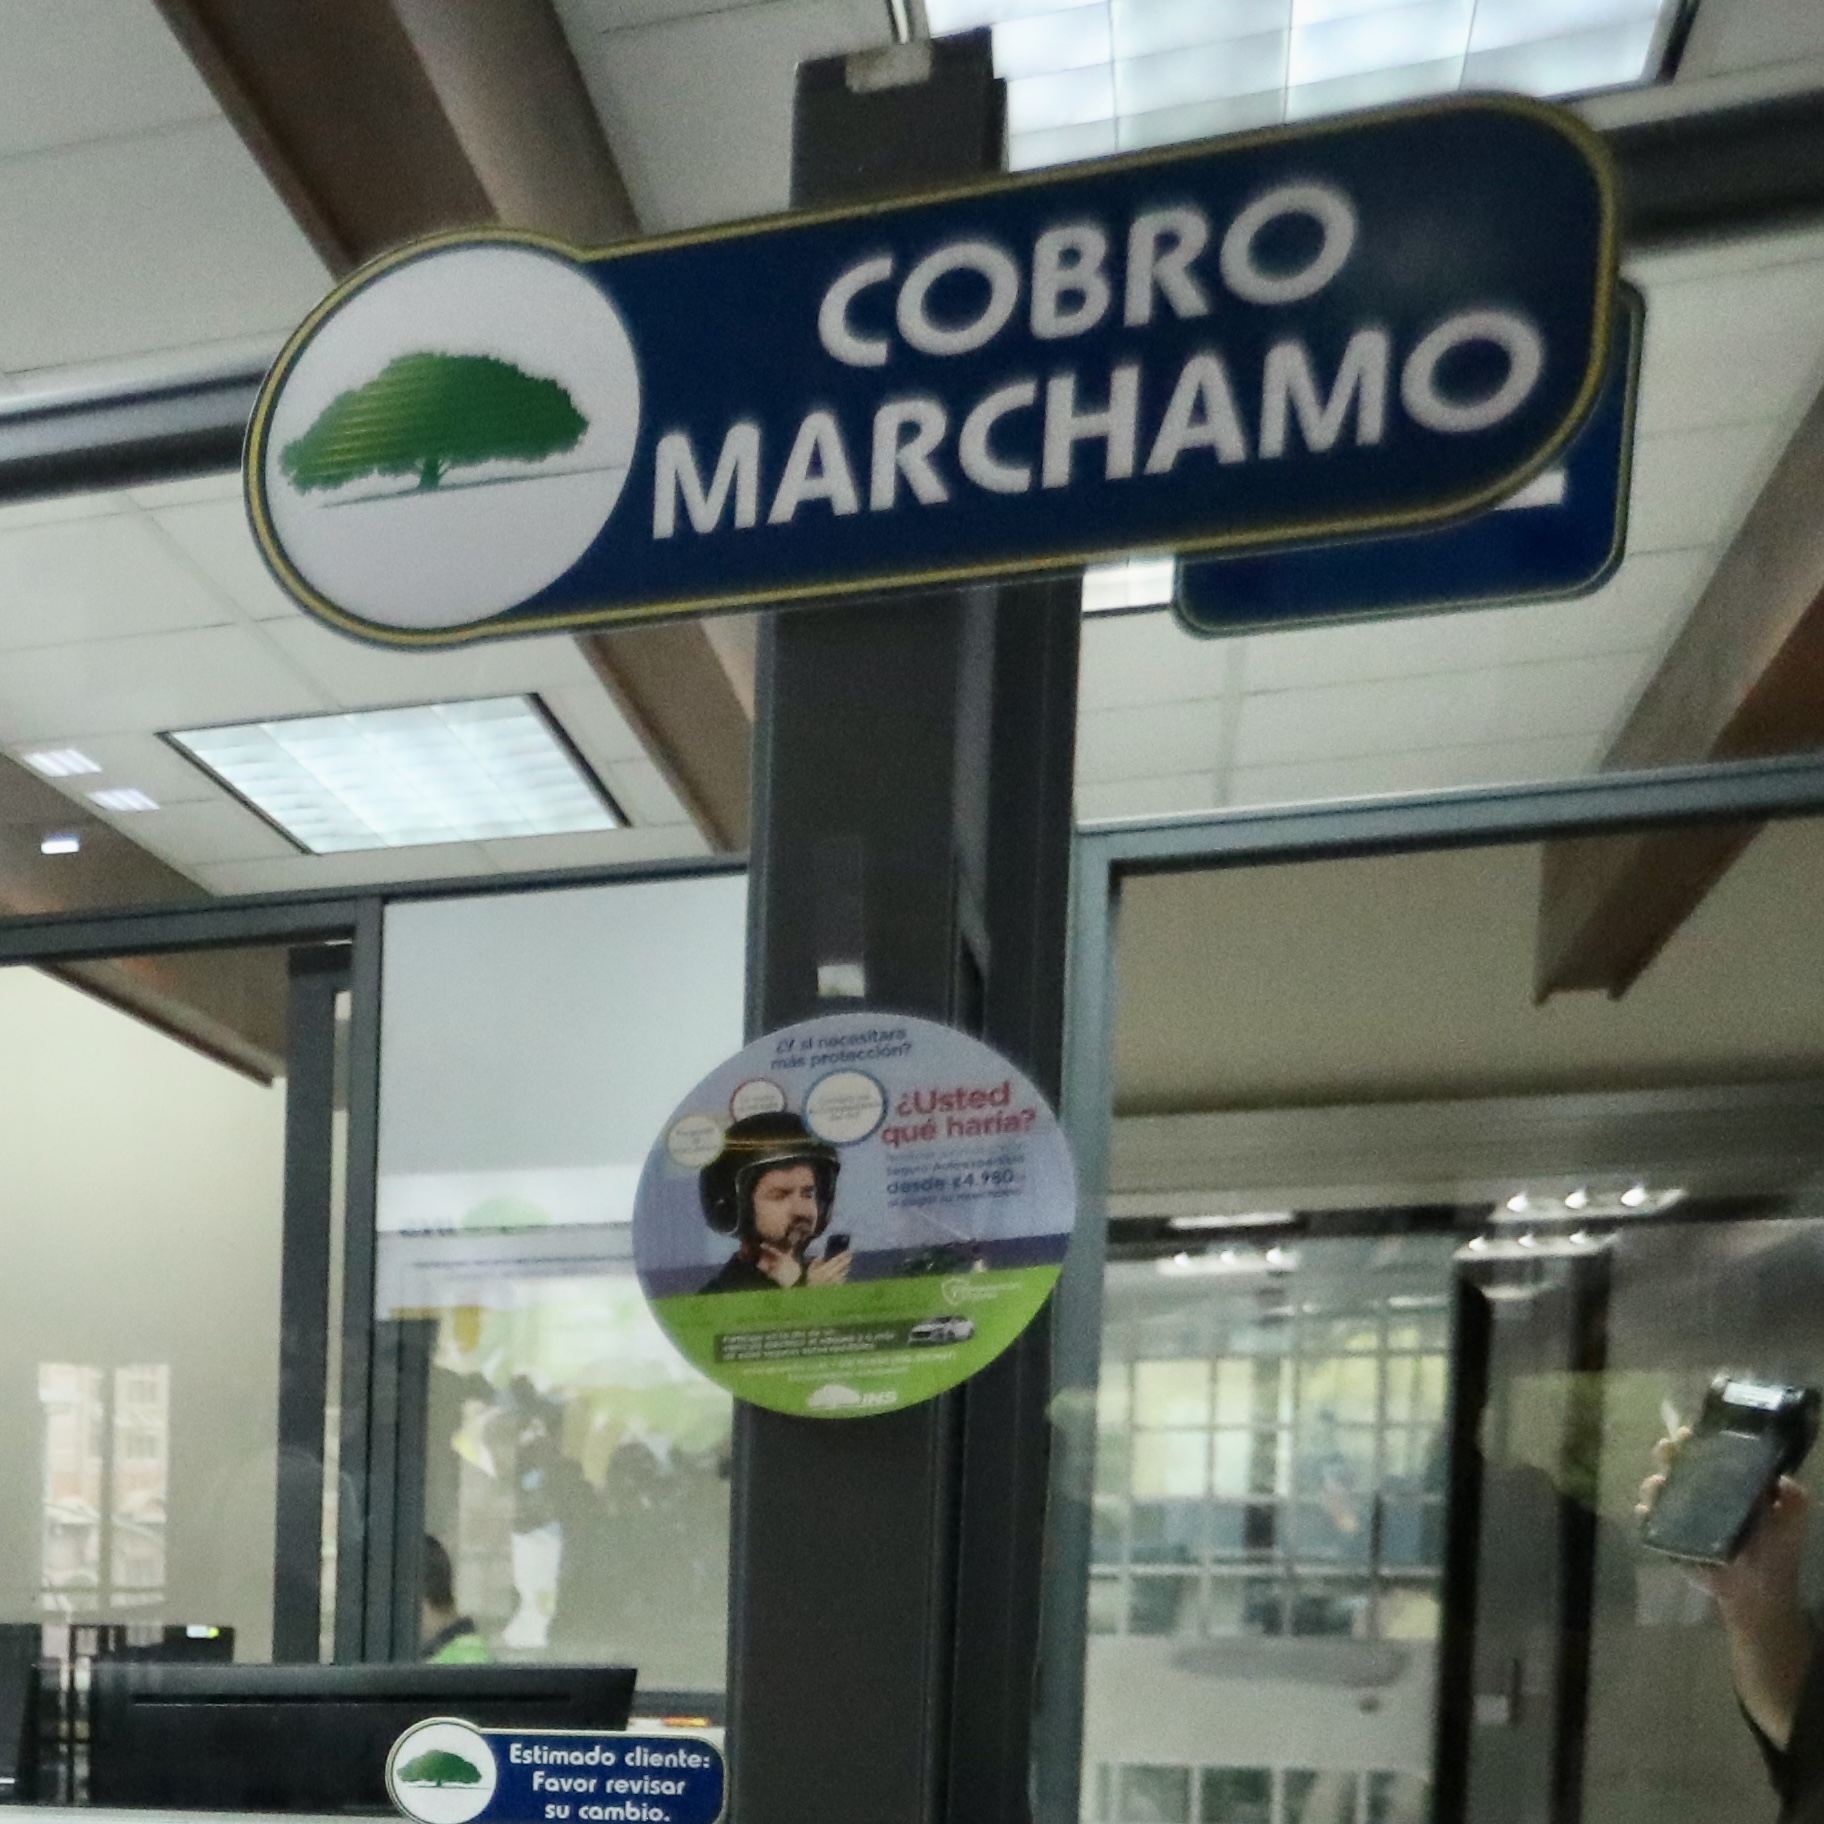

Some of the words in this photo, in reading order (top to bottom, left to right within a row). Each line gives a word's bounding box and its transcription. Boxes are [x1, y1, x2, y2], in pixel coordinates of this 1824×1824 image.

[817, 180, 1356, 368] COBRO
[650, 306, 1544, 541] MARCHAMO
[897, 1080, 1011, 1118] ¿Usted
[881, 1117, 937, 1148] qué
[946, 1107, 1037, 1137] haría?
[509, 1742, 616, 1766] Estimado
[624, 1745, 711, 1768] cliente:
[532, 1771, 598, 1794] Favor
[605, 1775, 686, 1796] revisar
[544, 1803, 570, 1820] su
[578, 1800, 672, 1823] cambio.
